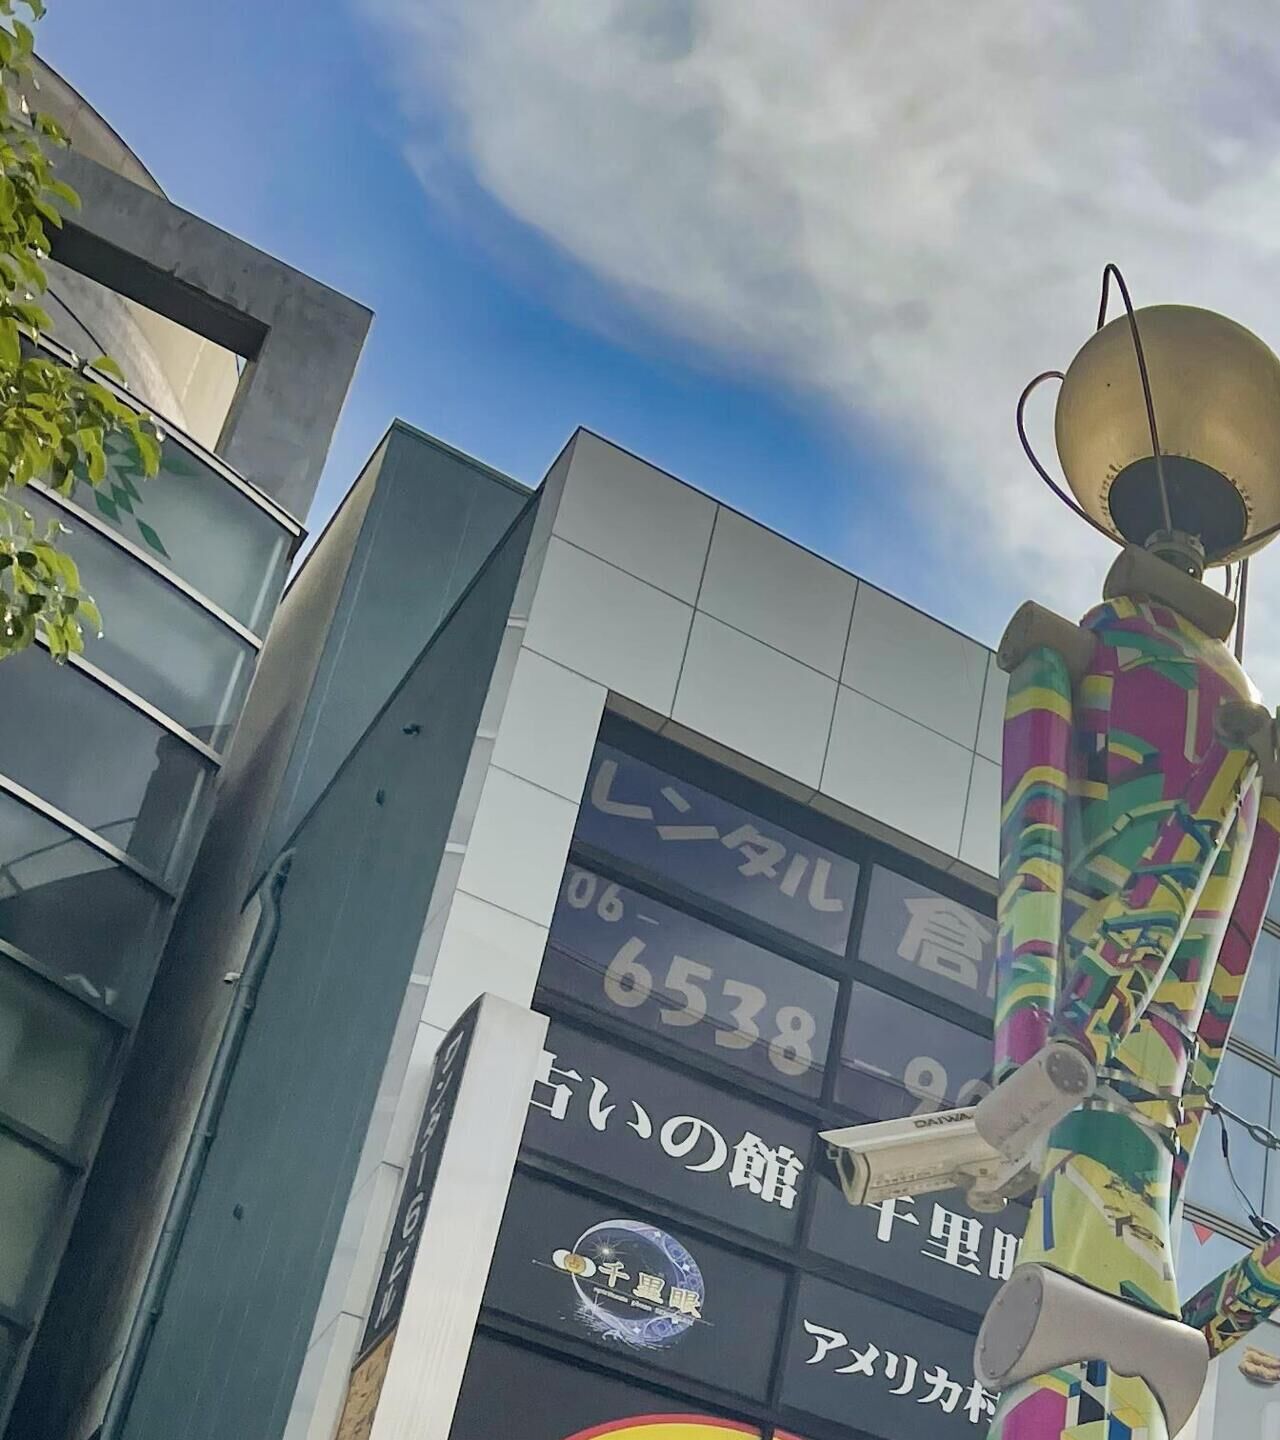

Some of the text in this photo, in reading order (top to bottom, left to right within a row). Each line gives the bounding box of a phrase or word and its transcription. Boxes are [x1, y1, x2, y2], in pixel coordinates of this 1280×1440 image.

[592, 760, 996, 998] レンタル 倉
[604, 938, 818, 1076] 6538
[598, 1260, 702, 1318] 千里眼
